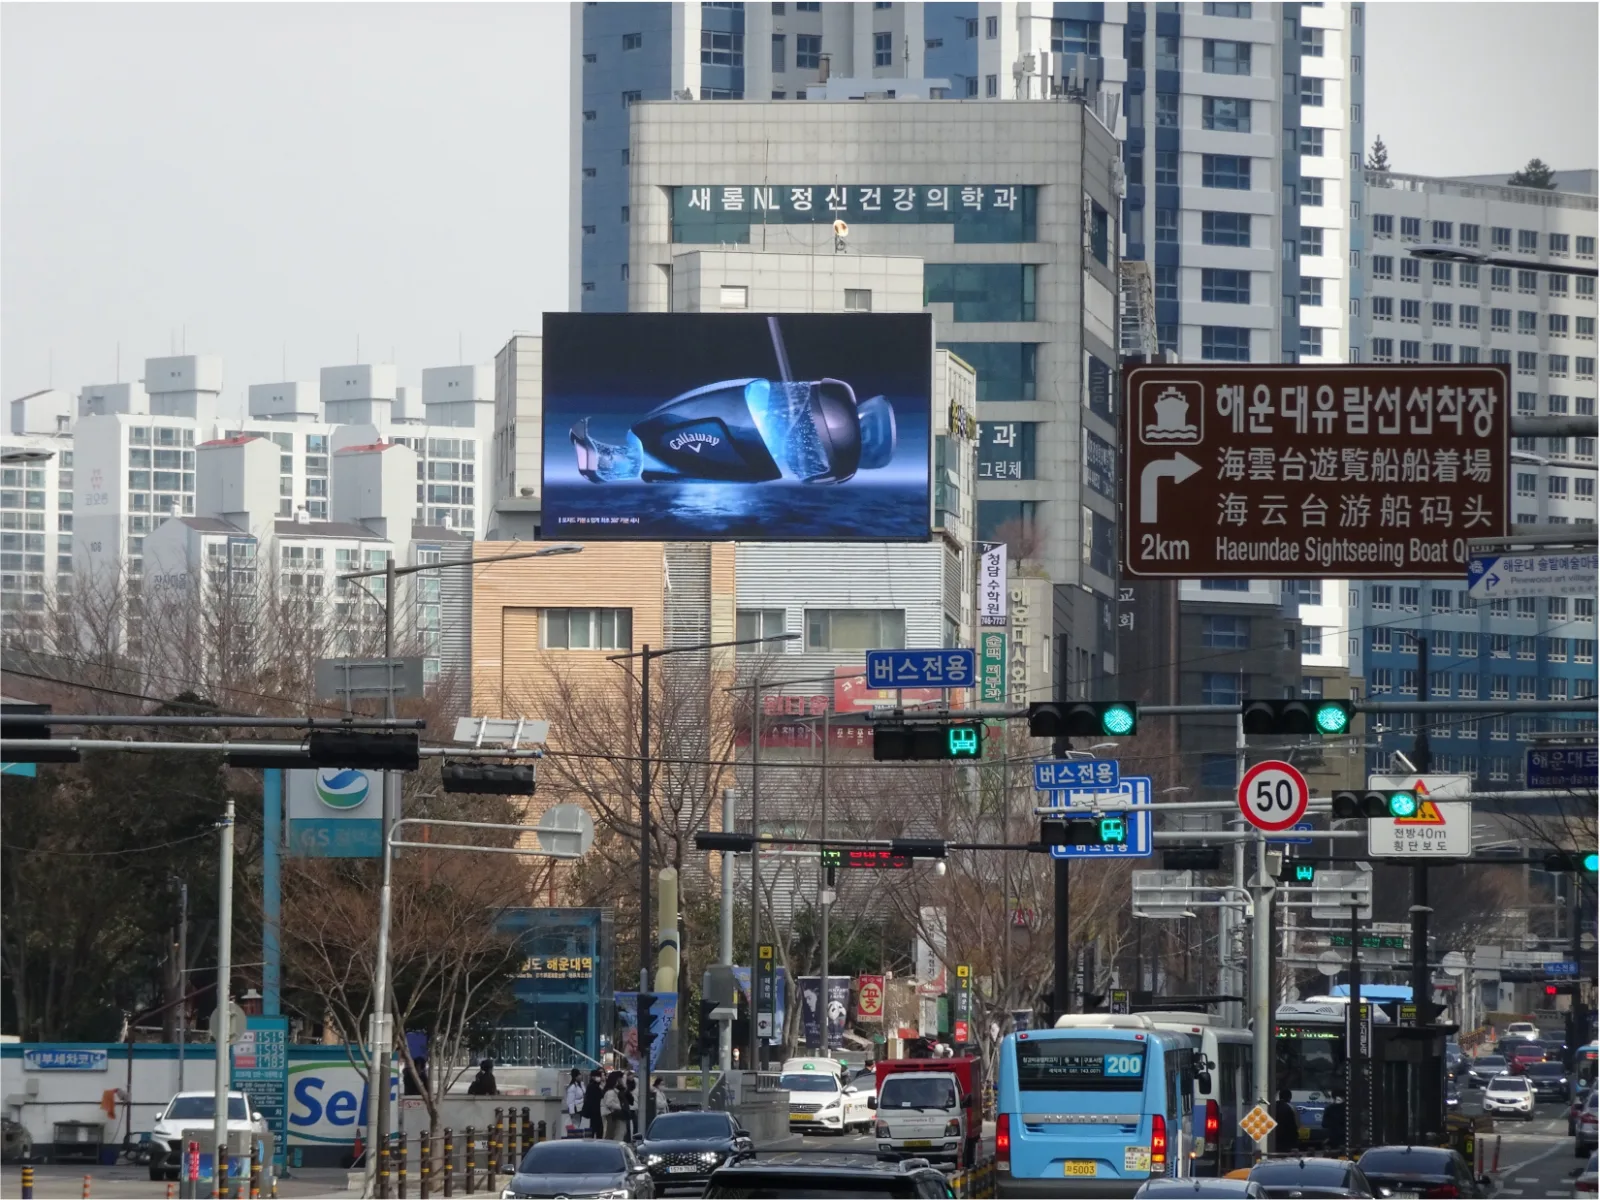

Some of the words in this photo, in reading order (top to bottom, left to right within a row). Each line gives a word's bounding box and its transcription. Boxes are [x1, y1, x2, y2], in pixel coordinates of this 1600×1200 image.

[1216, 384, 1497, 437] 해운대유람선선착장
[669, 432, 720, 450] Callaway
[1217, 446, 1492, 483] 海雲台遊覧船船着場
[1217, 492, 1493, 529] 海云台游船码头
[1141, 533, 1190, 561] 2km
[1216, 536, 1300, 562] Haeundae
[1305, 537, 1404, 567] Sightseeing
[1410, 538, 1448, 562] Boat
[1503, 558, 1535, 573] 해운대
[986, 552, 1000, 616] 청담수학원
[1510, 575, 1552, 585] Pinewood
[1554, 575, 1566, 583] art
[874, 654, 968, 682] 버스전용
[985, 664, 1001, 701] 피부과
[1532, 751, 1598, 770] 해운대로
[1039, 763, 1114, 785] 버스전용
[1256, 779, 1293, 812] 50
[301, 828, 329, 846] GS
[1393, 840, 1447, 851] 횡단보도
[546, 957, 592, 971] 해운대역
[765, 962, 771, 971] 4
[962, 979, 967, 988] 2
[862, 988, 879, 1009] 꽃
[259, 1031, 285, 1043] 1519
[1107, 1056, 1141, 1074] 200
